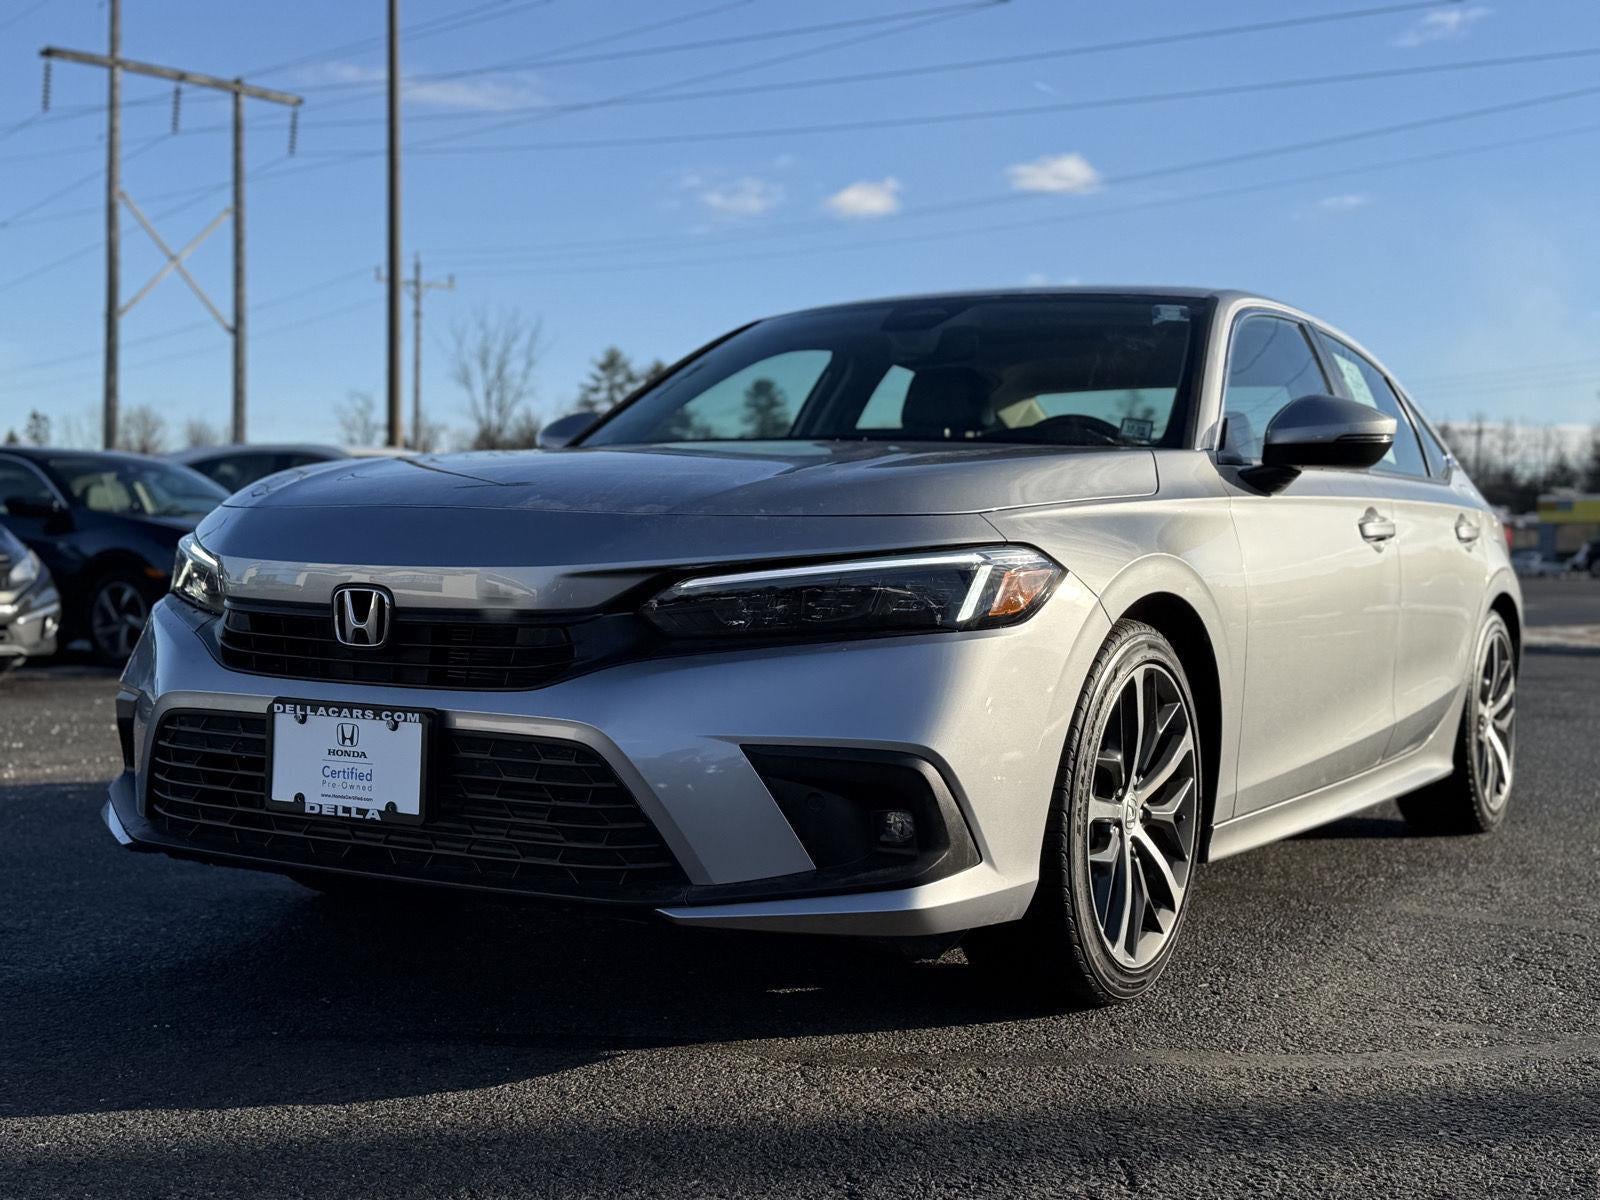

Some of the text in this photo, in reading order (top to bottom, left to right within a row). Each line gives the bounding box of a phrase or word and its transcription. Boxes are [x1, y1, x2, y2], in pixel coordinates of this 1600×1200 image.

[273, 703, 420, 723] DELLACARS.COM
[327, 748, 368, 759] HONDA
[321, 765, 373, 782] Certified
[321, 779, 373, 792] Pre-Owned
[304, 802, 382, 821] DELLA
